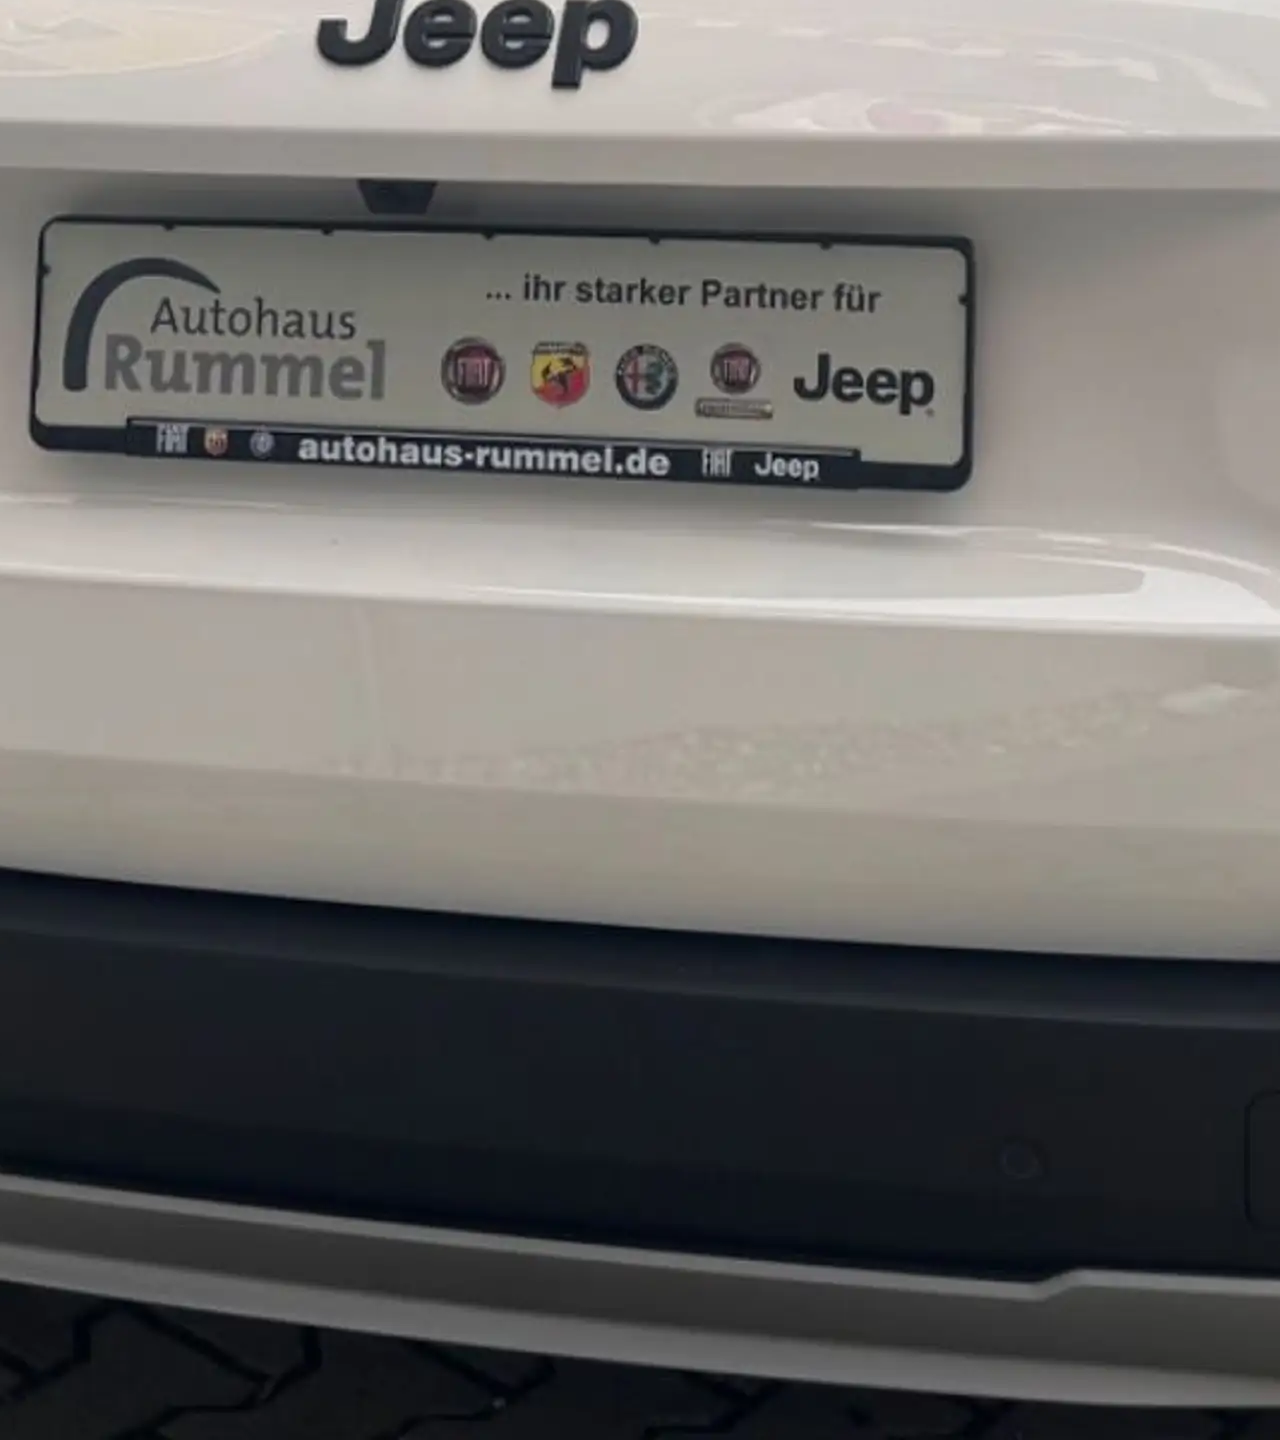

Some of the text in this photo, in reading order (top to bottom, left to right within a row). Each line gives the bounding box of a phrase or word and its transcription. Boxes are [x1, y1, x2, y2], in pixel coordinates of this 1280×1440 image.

[523, 271, 568, 303] ihr
[574, 276, 693, 306] starker
[701, 278, 825, 312] Partner
[832, 281, 883, 314] für
[149, 296, 357, 341] Autohaus
[103, 332, 387, 401] Rummel
[792, 350, 935, 417] Jeep
[297, 435, 671, 476] autohaus-rummel.de
[754, 452, 820, 482] Jeep
